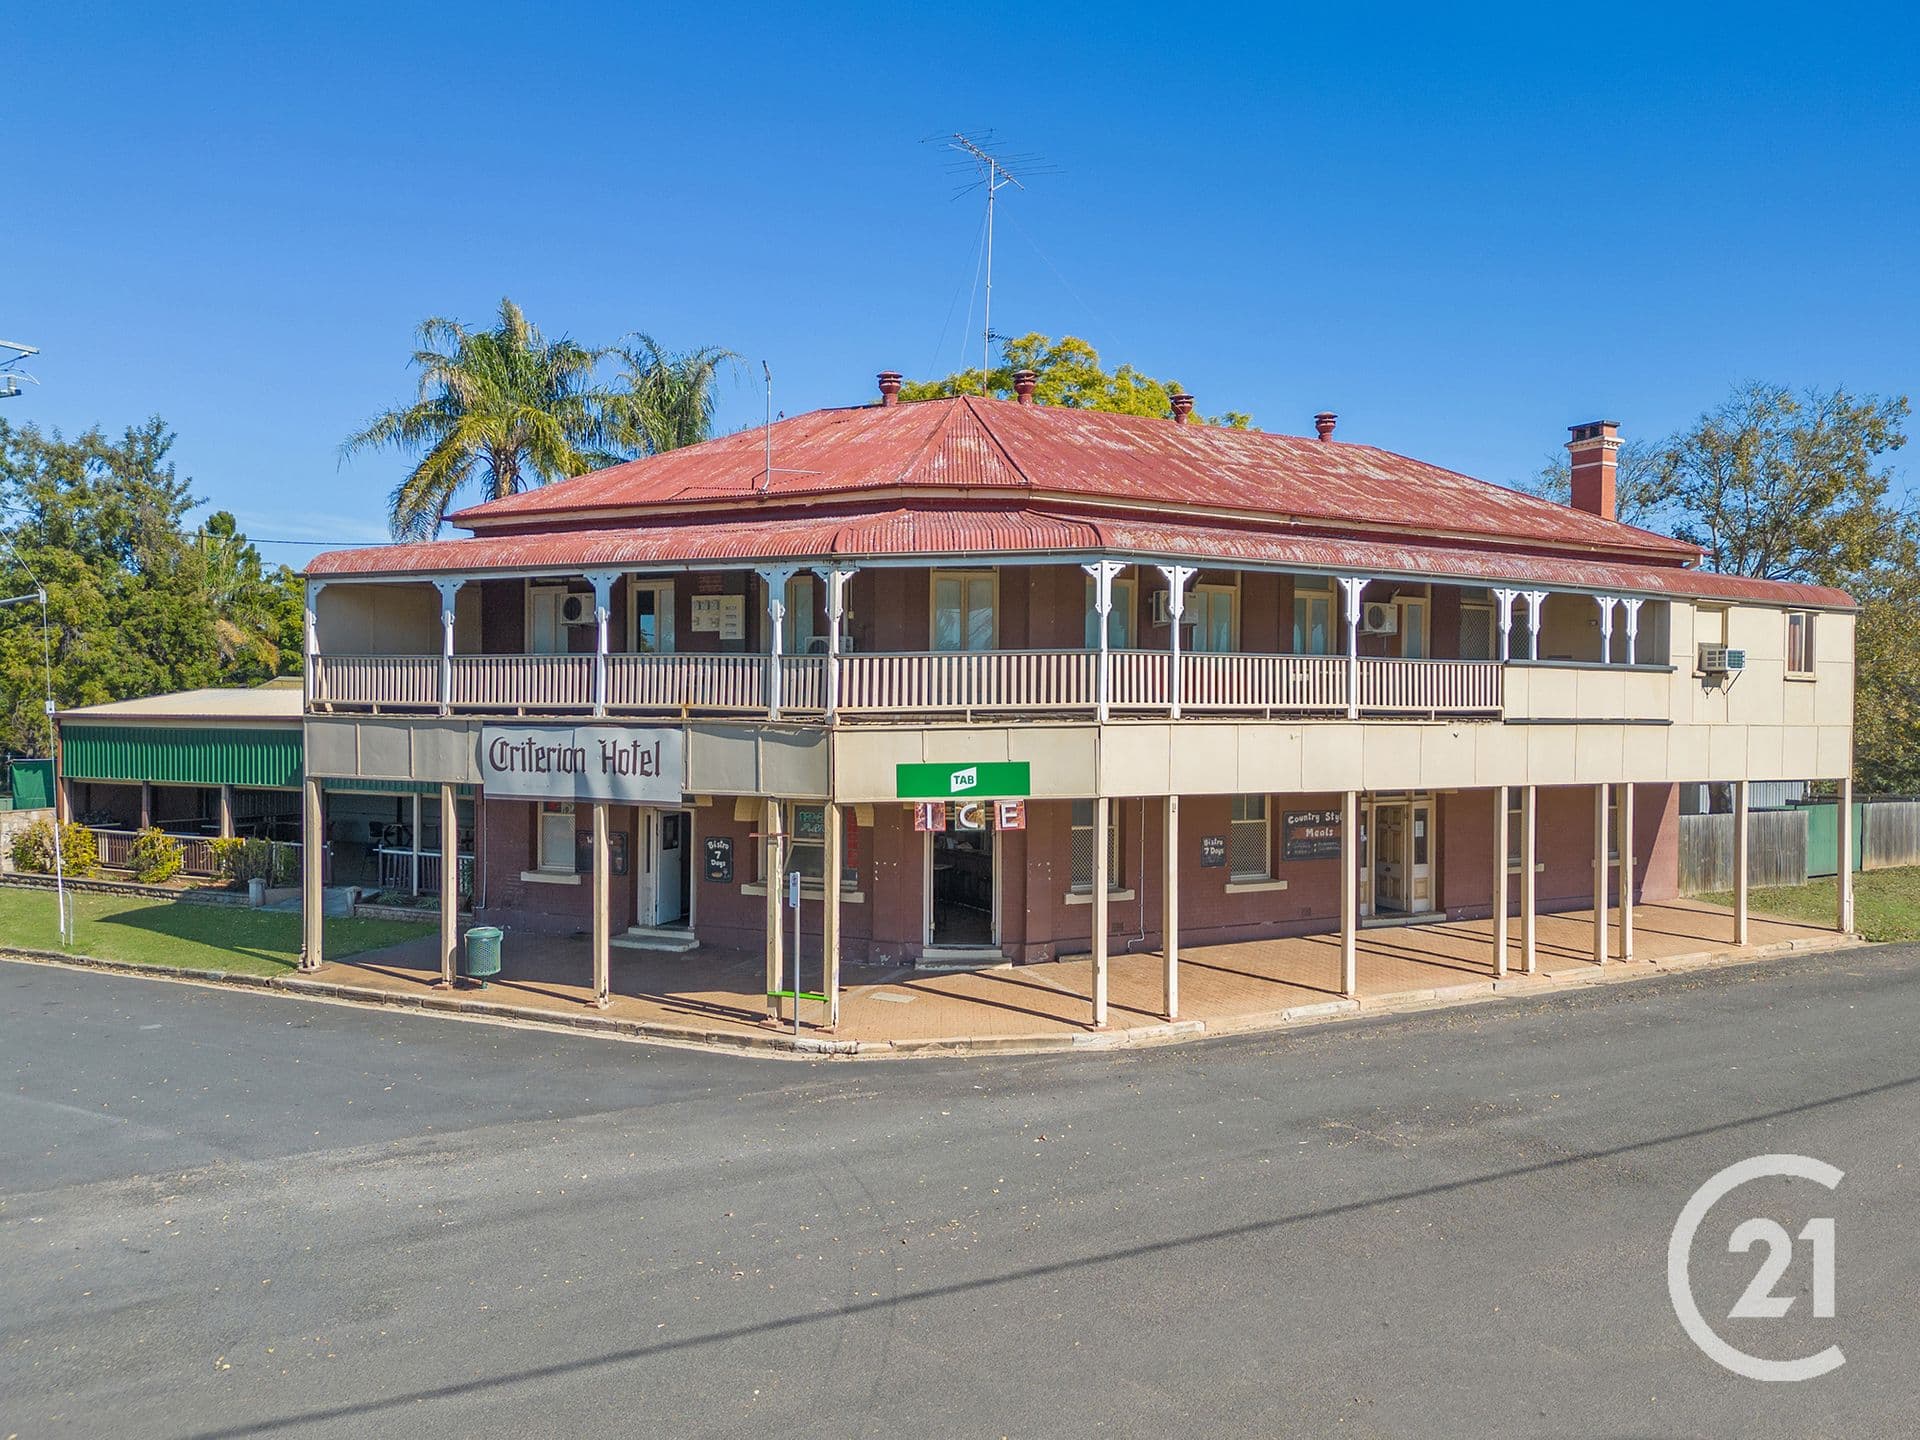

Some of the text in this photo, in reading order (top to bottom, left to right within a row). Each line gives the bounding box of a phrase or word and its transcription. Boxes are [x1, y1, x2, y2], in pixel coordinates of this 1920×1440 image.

[489, 736, 661, 778] Criterion Hotel
[953, 775, 975, 785] TAB
[926, 803, 1018, 829] ICE
[1287, 811, 1344, 824] Country Styl
[1305, 827, 1334, 837] Meals
[707, 840, 729, 850] Bistro
[1203, 838, 1223, 846] Bistro
[714, 851, 721, 859] 7
[1203, 847, 1224, 856] 7 Days
[710, 859, 726, 869] Days
